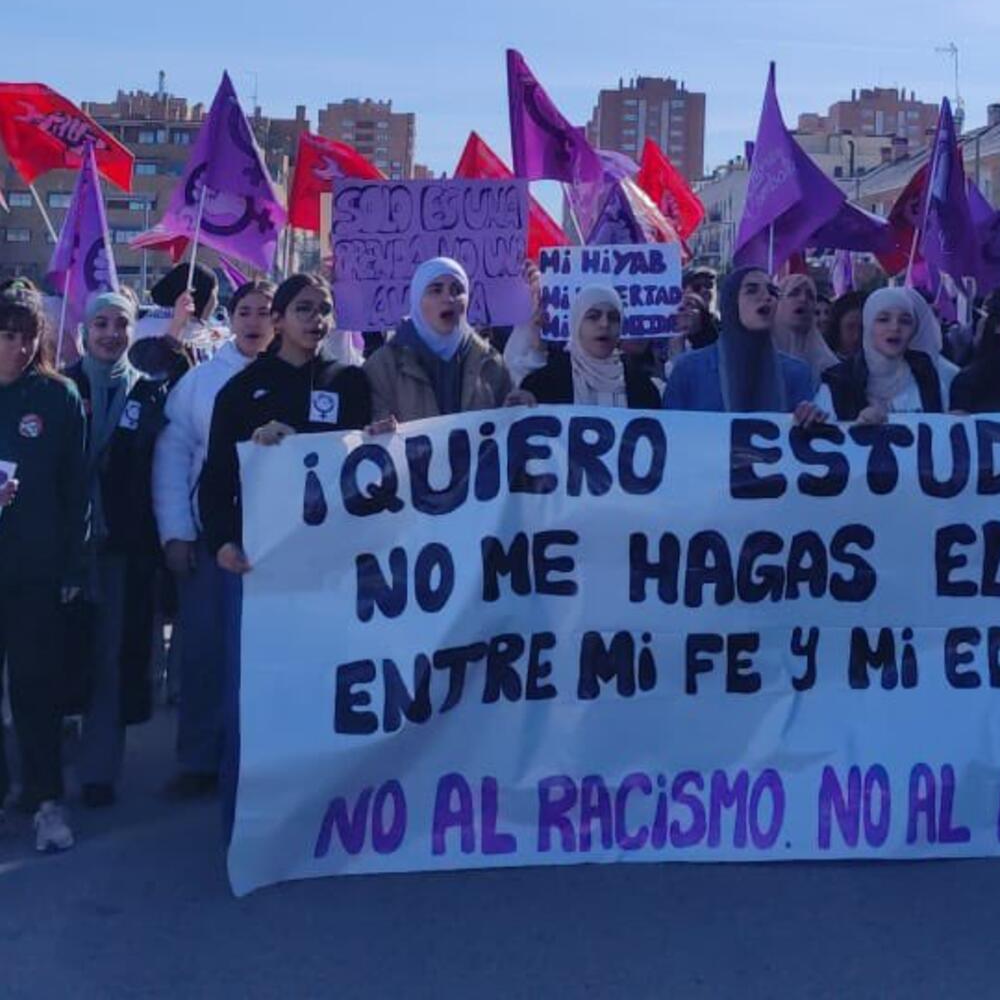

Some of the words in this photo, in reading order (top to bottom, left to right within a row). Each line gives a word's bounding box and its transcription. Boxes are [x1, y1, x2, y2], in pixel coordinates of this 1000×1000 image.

[356, 542, 455, 623] NO
[481, 529, 579, 602] ME
[628, 523, 877, 607] HAGAS
[333, 631, 558, 735] ENTRE
[684, 632, 761, 694] FE
[314, 779, 408, 859] NO
[431, 772, 517, 857] AL
[817, 764, 891, 850] NO
[906, 763, 972, 845] AL
